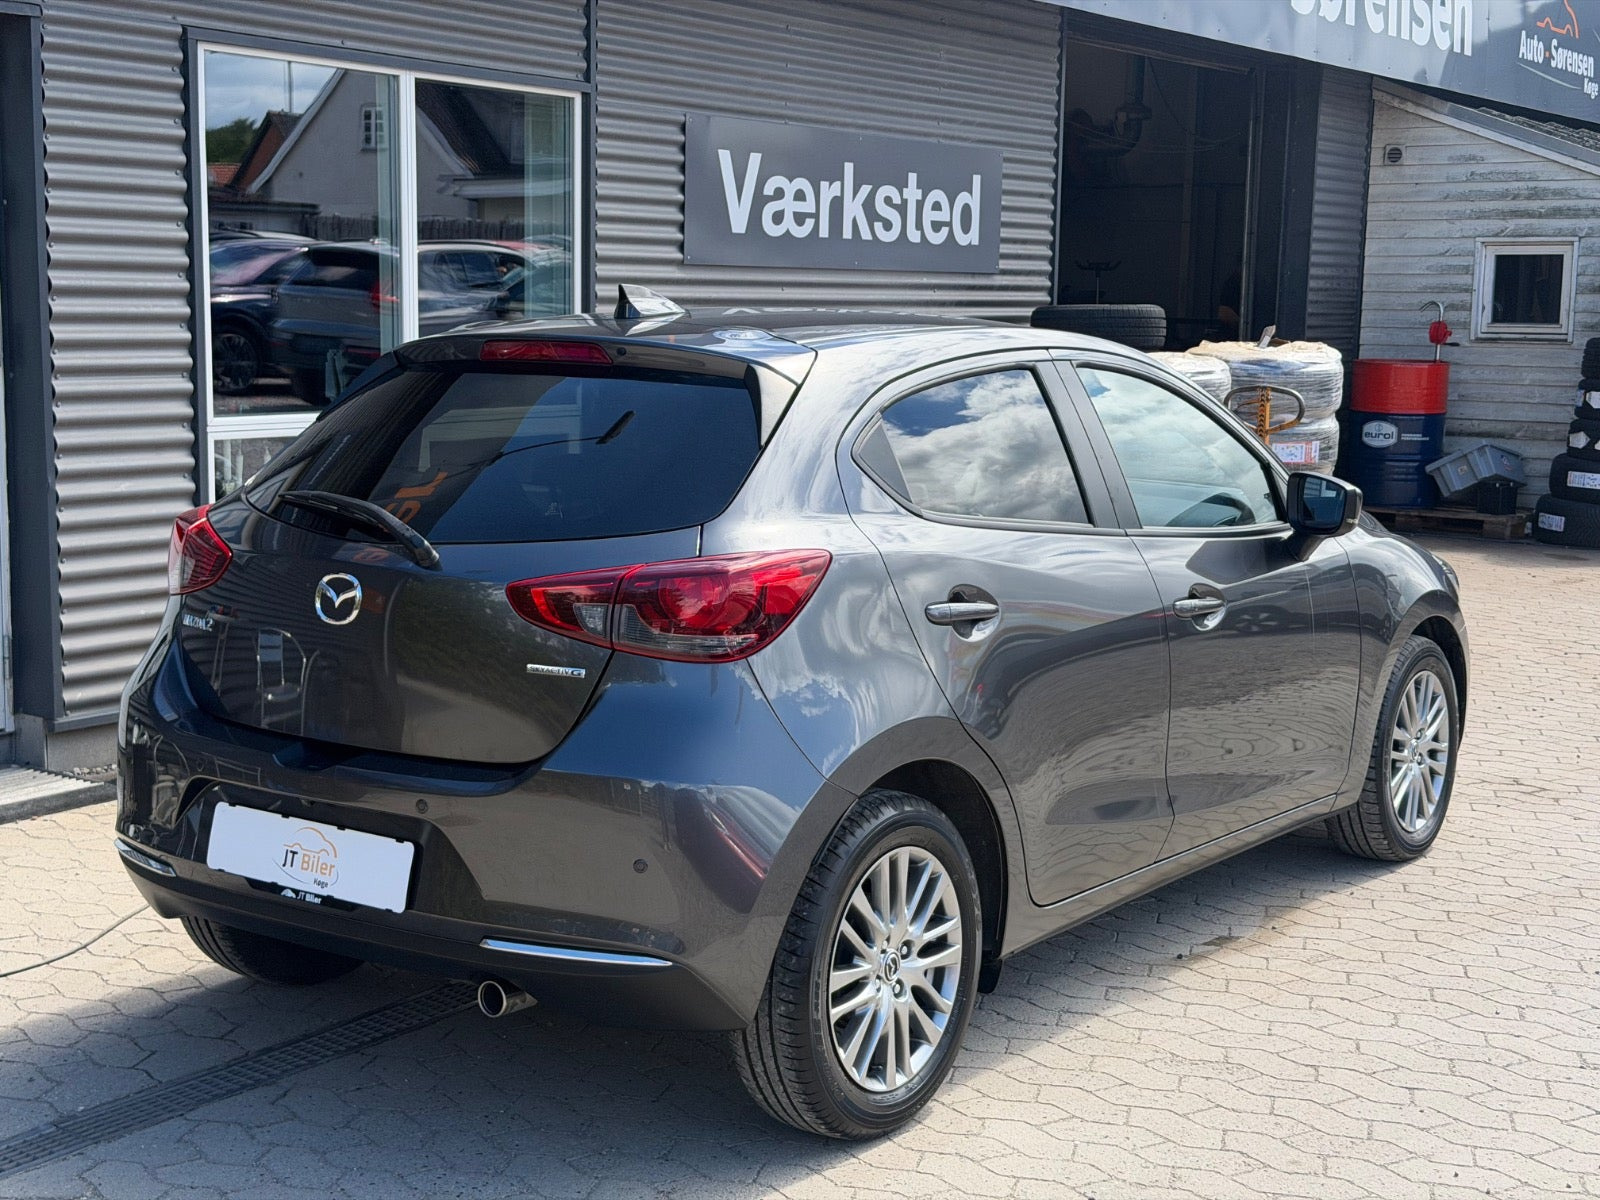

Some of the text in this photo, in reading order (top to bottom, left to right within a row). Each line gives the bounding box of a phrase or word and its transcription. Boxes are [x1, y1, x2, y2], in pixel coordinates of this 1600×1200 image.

[1519, 30, 1594, 78] Auto Sørensen
[717, 148, 982, 246] Værksted
[1364, 431, 1394, 440] eurol
[282, 849, 335, 877] JT Biler
[313, 878, 329, 889] Køge
